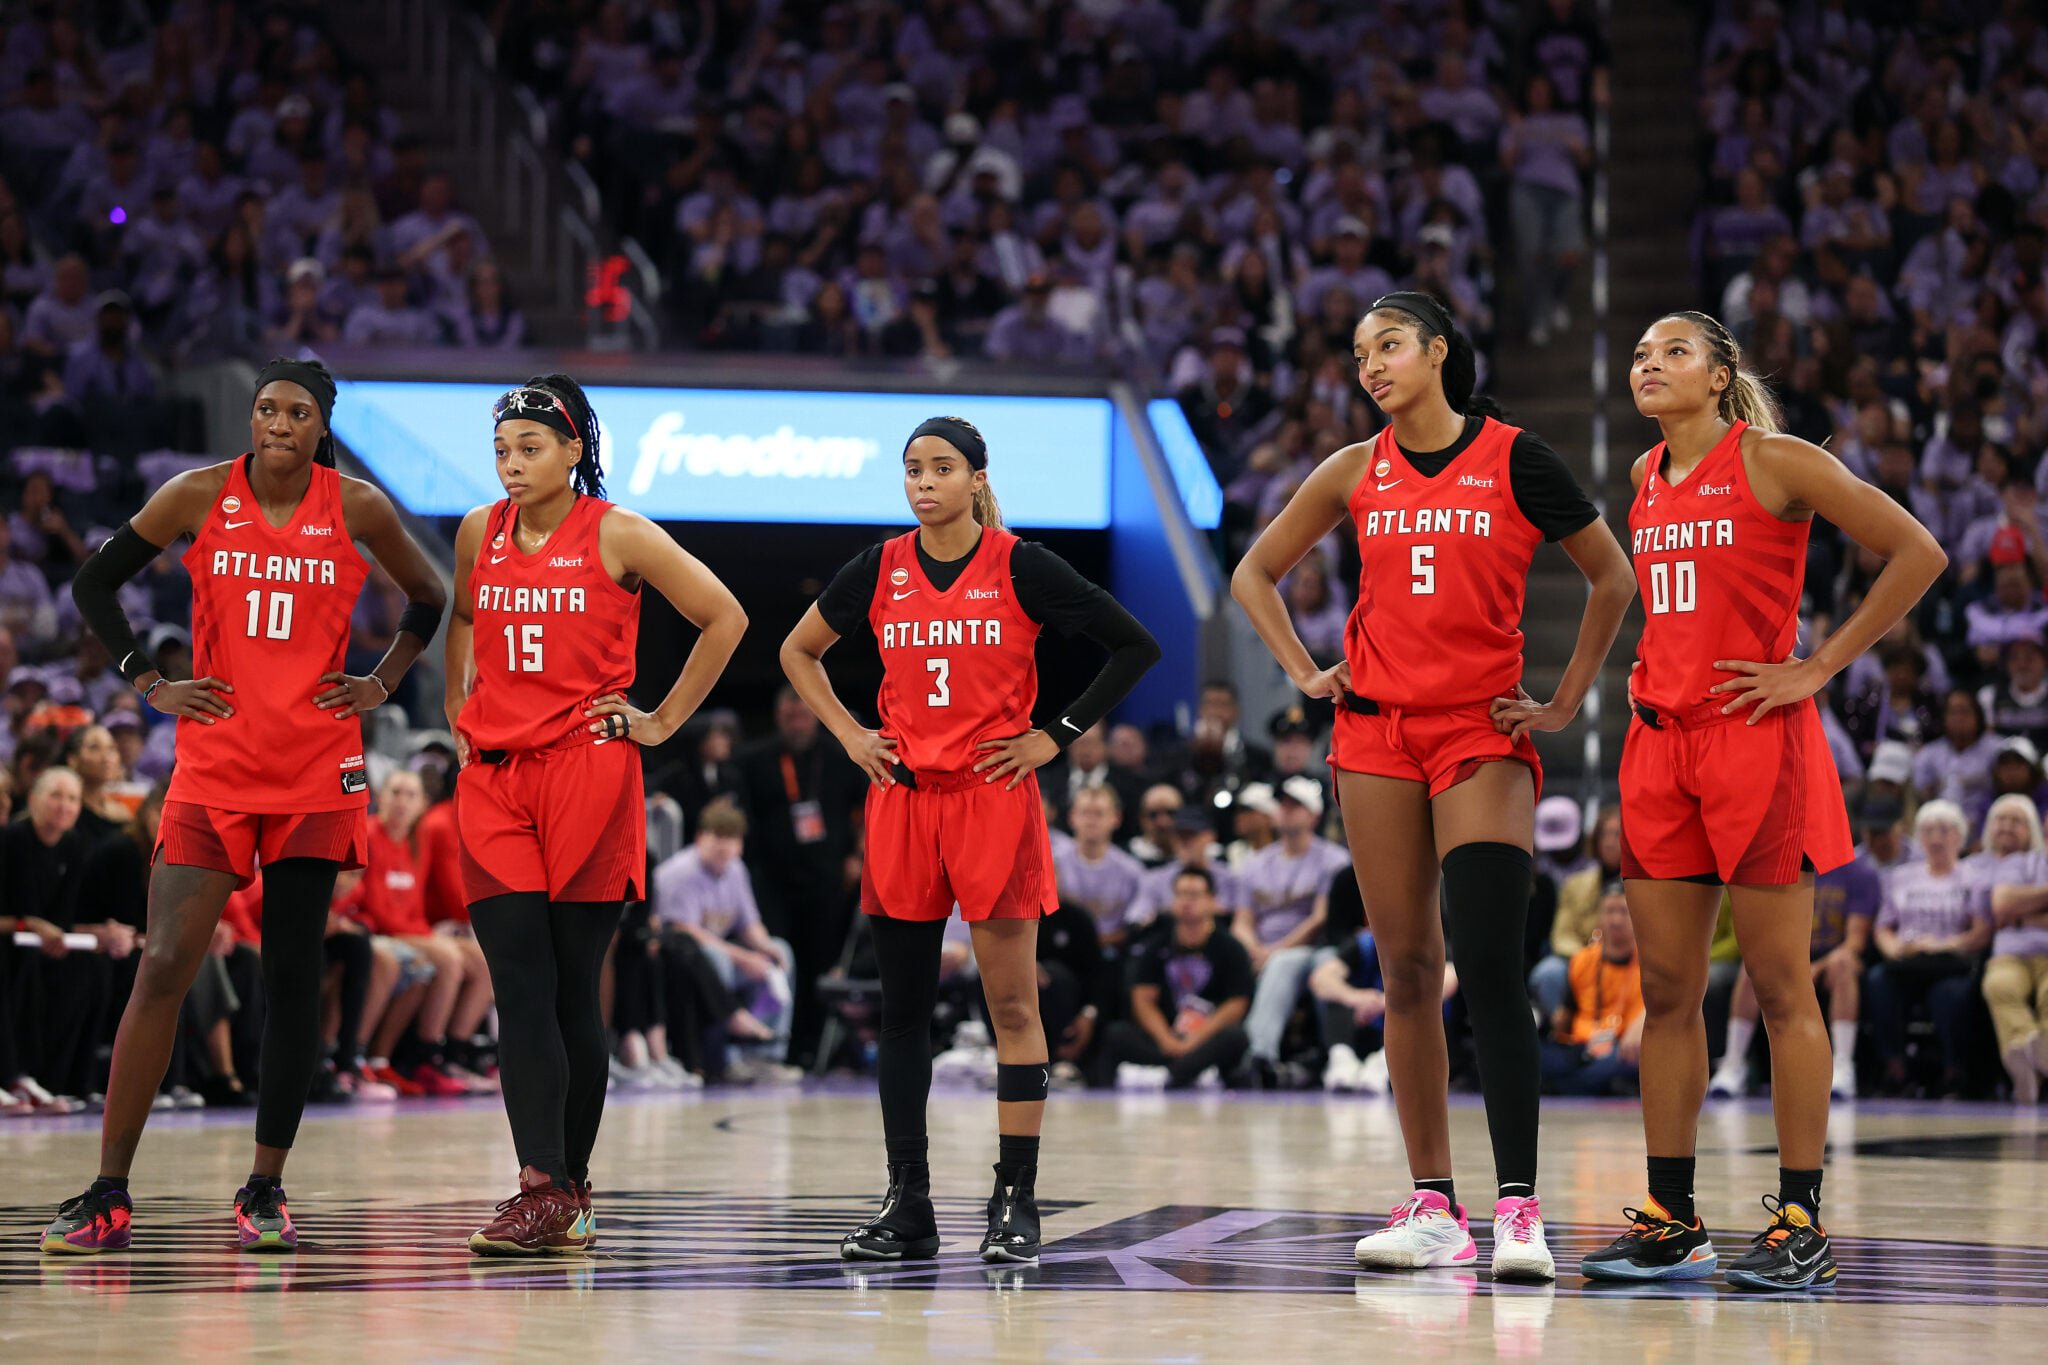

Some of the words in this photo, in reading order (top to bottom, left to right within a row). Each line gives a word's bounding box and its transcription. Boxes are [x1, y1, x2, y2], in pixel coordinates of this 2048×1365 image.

[629, 411, 868, 496] freedom
[1457, 475, 1494, 488] Albert
[1698, 484, 1732, 497] Albert
[300, 525, 332, 537] Albert
[1366, 508, 1491, 537] ATLANTA
[1633, 518, 1734, 555] ATLANTA
[212, 550, 335, 585] ATLANTA
[549, 557, 583, 568] Albert
[1410, 544, 1435, 595] 5
[478, 584, 586, 613] ATLANTA
[964, 589, 1000, 600] Albert
[1650, 560, 1697, 614] 00
[245, 589, 295, 641] 10
[503, 624, 544, 672] 15
[883, 618, 1001, 649] ATLANTA
[926, 657, 950, 708] 3
